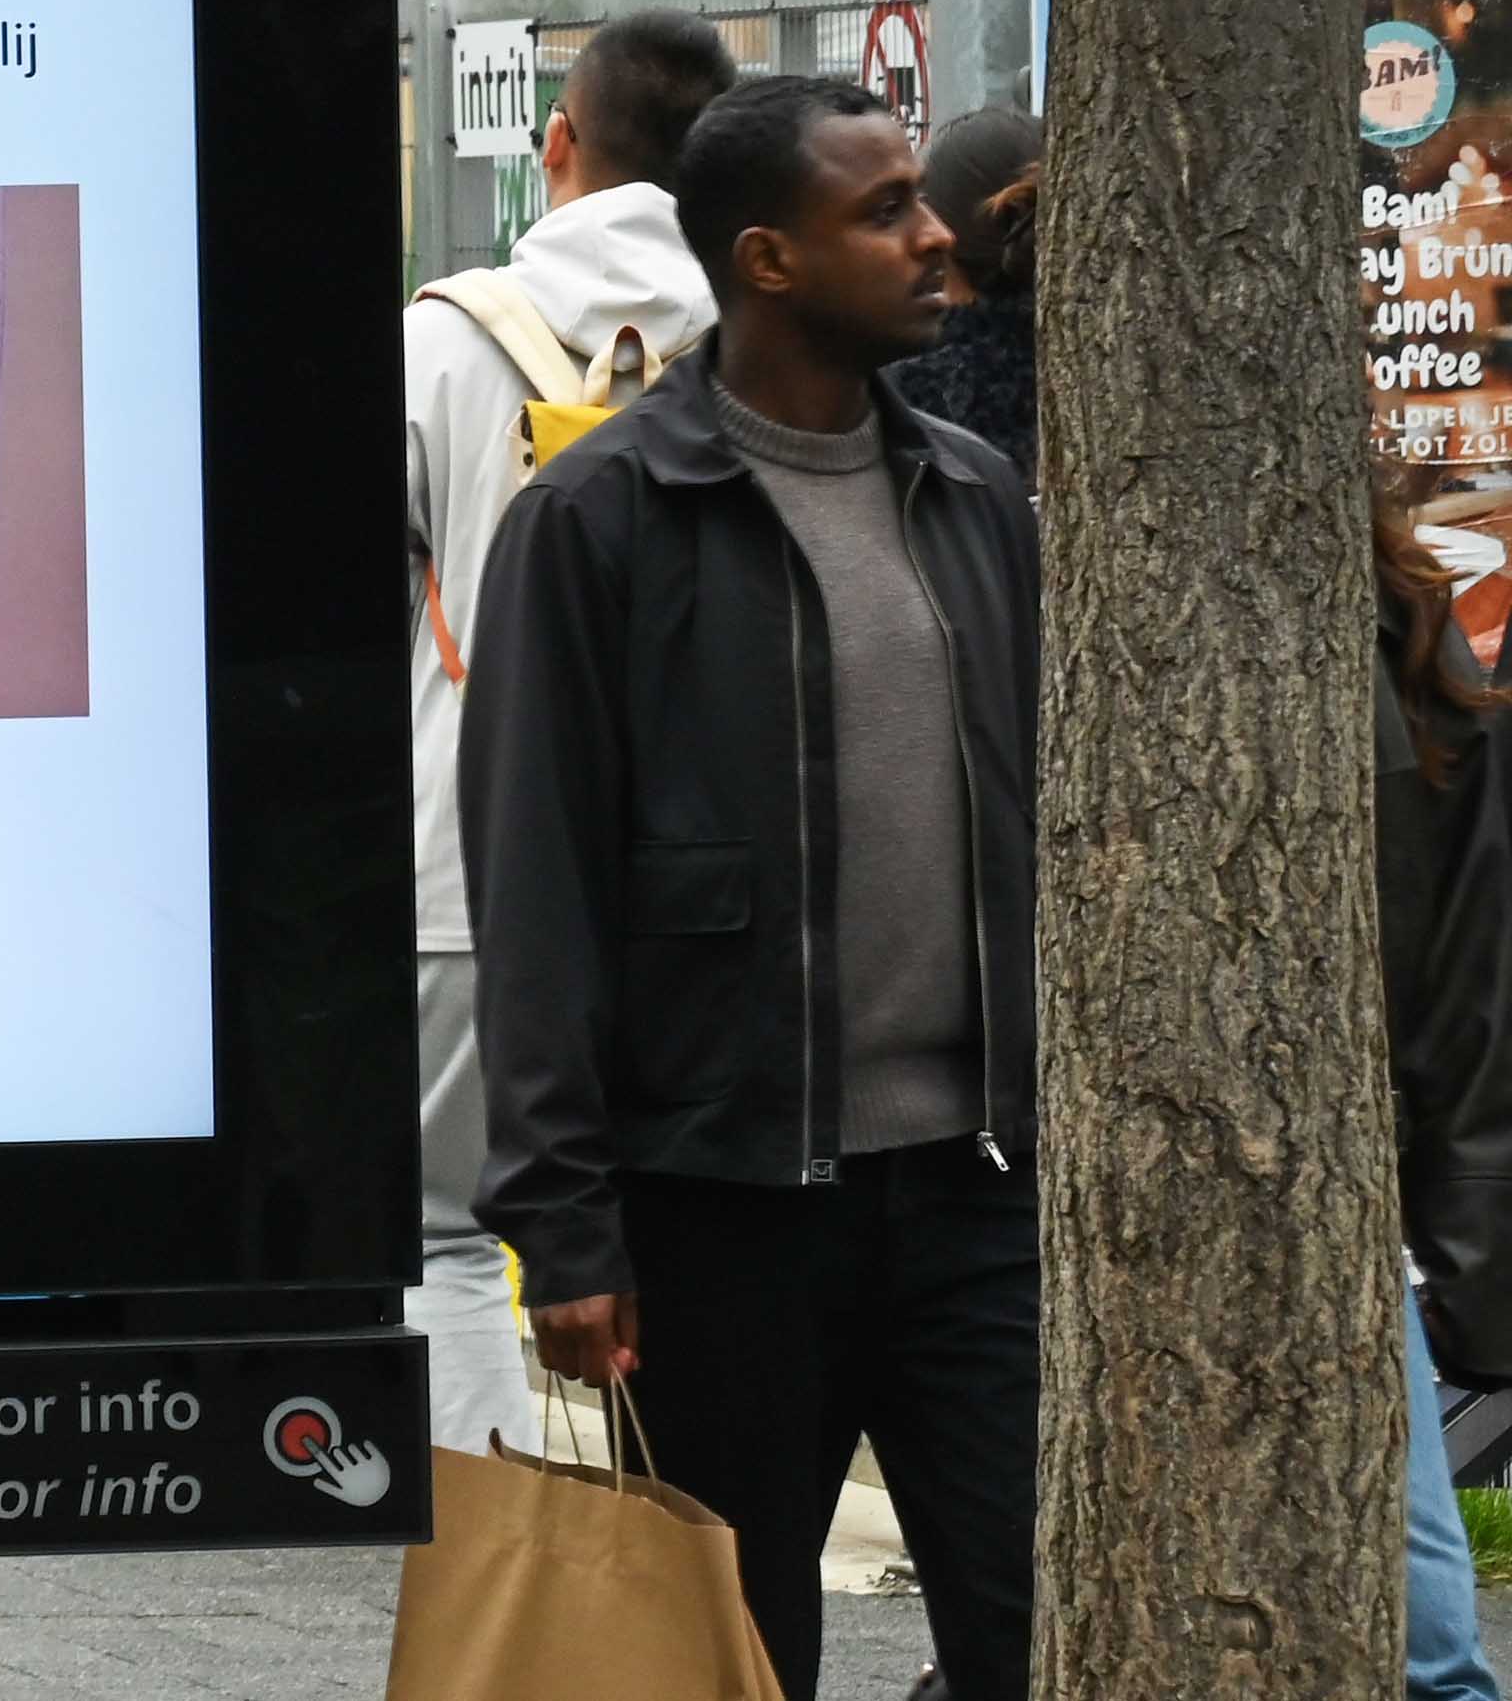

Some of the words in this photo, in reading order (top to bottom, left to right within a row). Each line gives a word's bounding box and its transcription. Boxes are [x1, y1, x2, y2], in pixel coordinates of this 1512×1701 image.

[459, 46, 528, 130] intrit
[1360, 247, 1406, 296] ay
[1370, 288, 1475, 335] unch
[1366, 343, 1483, 391] offee
[1390, 406, 1481, 430] LOPEN
[1396, 434, 1448, 458] TOT
[80, 1379, 200, 1431] info
[80, 1461, 202, 1517] info
